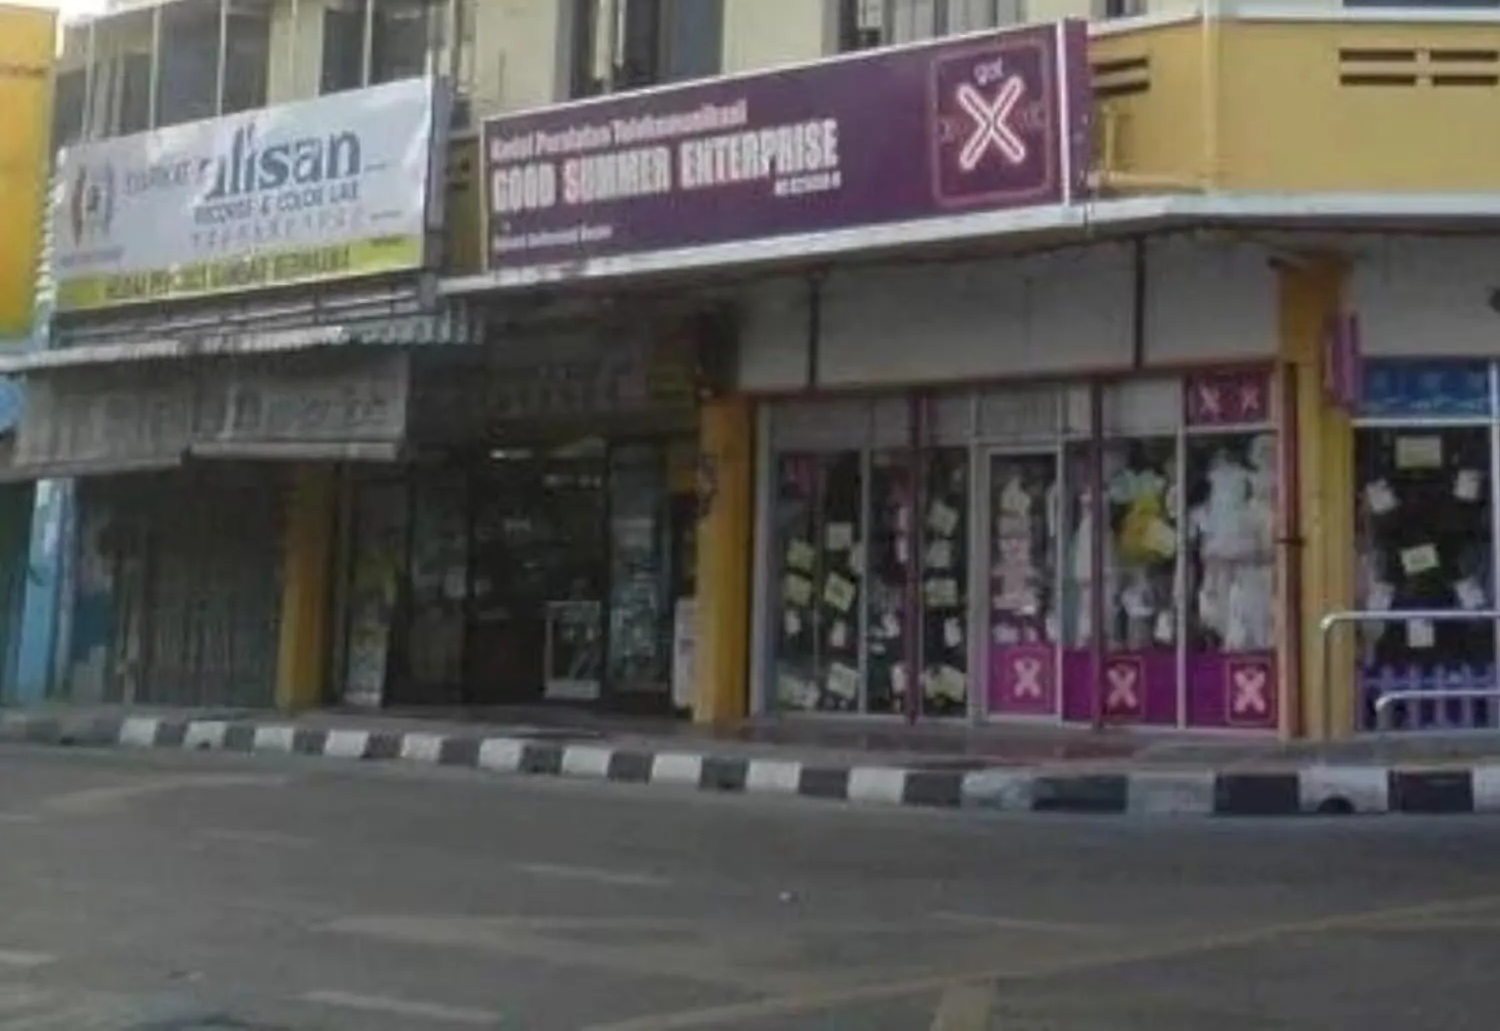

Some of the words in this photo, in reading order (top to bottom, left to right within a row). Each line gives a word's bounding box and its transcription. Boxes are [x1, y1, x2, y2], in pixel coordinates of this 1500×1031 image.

[493, 162, 556, 212] GOOD
[563, 146, 672, 205] SUMMER
[680, 117, 838, 191] ENTERPRISE
